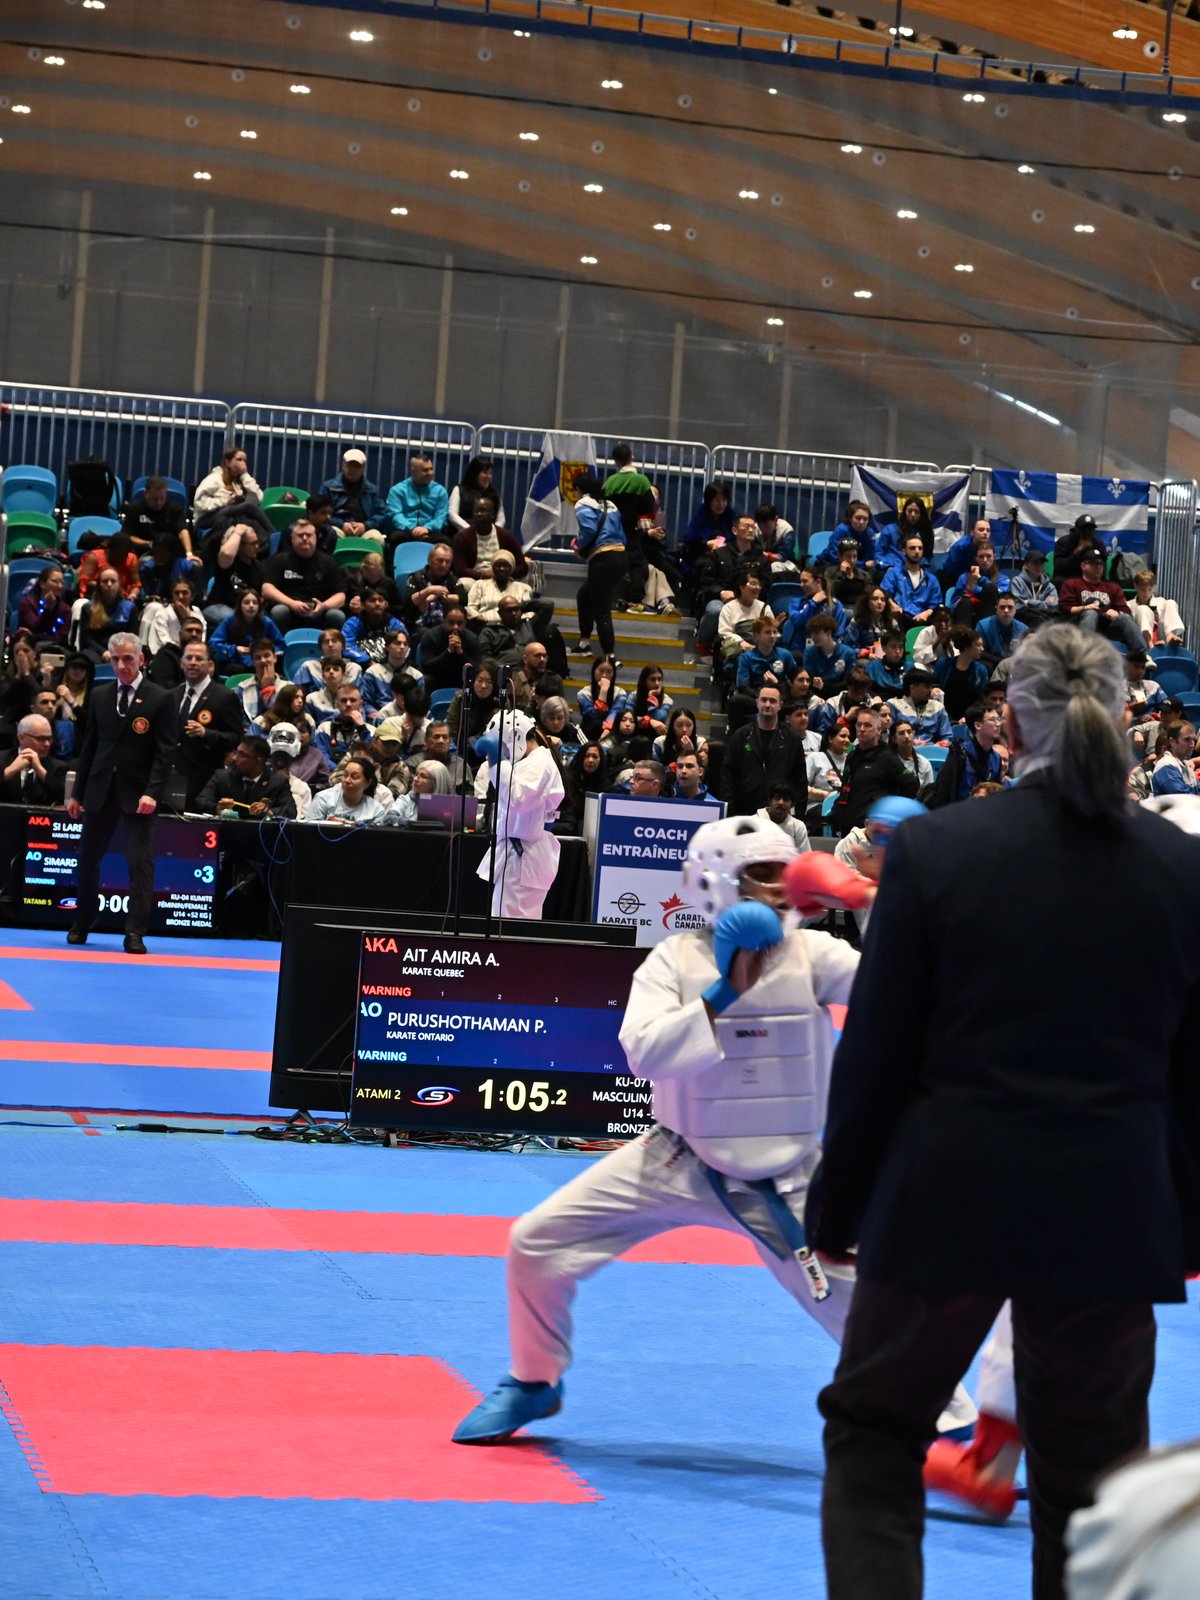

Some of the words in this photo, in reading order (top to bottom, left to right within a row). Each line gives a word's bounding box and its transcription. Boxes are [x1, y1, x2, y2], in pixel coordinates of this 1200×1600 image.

[28, 816, 51, 826] AKA
[633, 826, 688, 841] COACH
[205, 831, 217, 848] 3
[27, 842, 58, 850] WARNING
[25, 851, 42, 861] AO
[202, 865, 214, 883] 3
[25, 877, 56, 885] WARNING
[23, 897, 47, 905] TATAMI
[191, 920, 213, 928] MEDAL
[602, 916, 637, 925] KARATE
[402, 948, 428, 962] AIT
[431, 949, 482, 966] AMIRA
[485, 952, 500, 967] A.
[402, 966, 432, 976] KARATE
[433, 968, 465, 978] QUEBEC
[387, 1012, 530, 1033] PURUSHOTHAMAN
[534, 1019, 547, 1034] P.
[386, 1031, 416, 1040] KARATE
[418, 1032, 455, 1042] ONTARIO
[615, 1077, 646, 1088] KU-07
[355, 1087, 391, 1099] ATAMI
[394, 1089, 401, 1100] 2
[623, 1108, 643, 1119] U14
[607, 1122, 650, 1134] BRONZE
